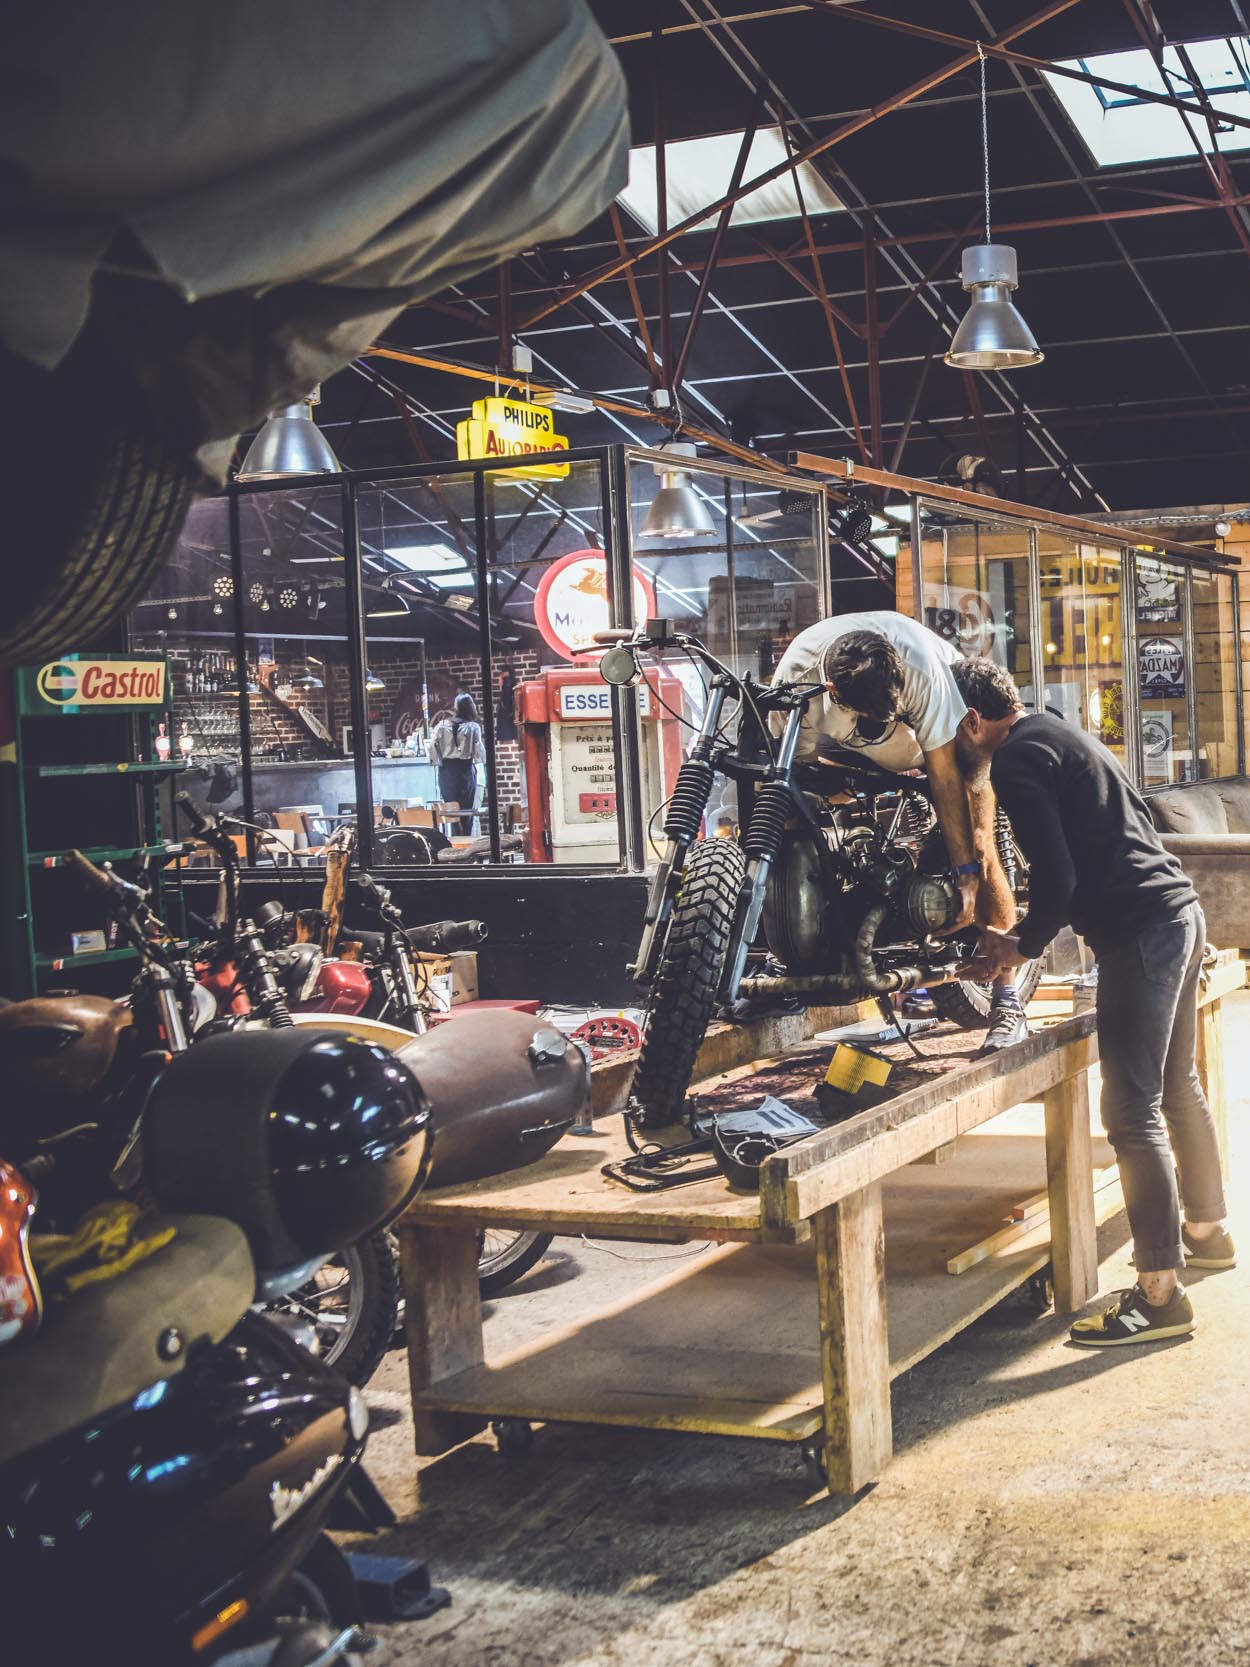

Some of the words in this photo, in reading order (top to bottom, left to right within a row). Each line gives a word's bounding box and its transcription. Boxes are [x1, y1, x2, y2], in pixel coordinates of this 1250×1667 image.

[504, 406, 550, 432] PHILIPS
[82, 666, 161, 700] Castrol
[415, 694, 440, 703] DNK
[565, 694, 646, 710] ESSEE
[575, 735, 594, 743] Prix
[571, 764, 604, 772] Quantité
[1118, 1308, 1150, 1333] N
